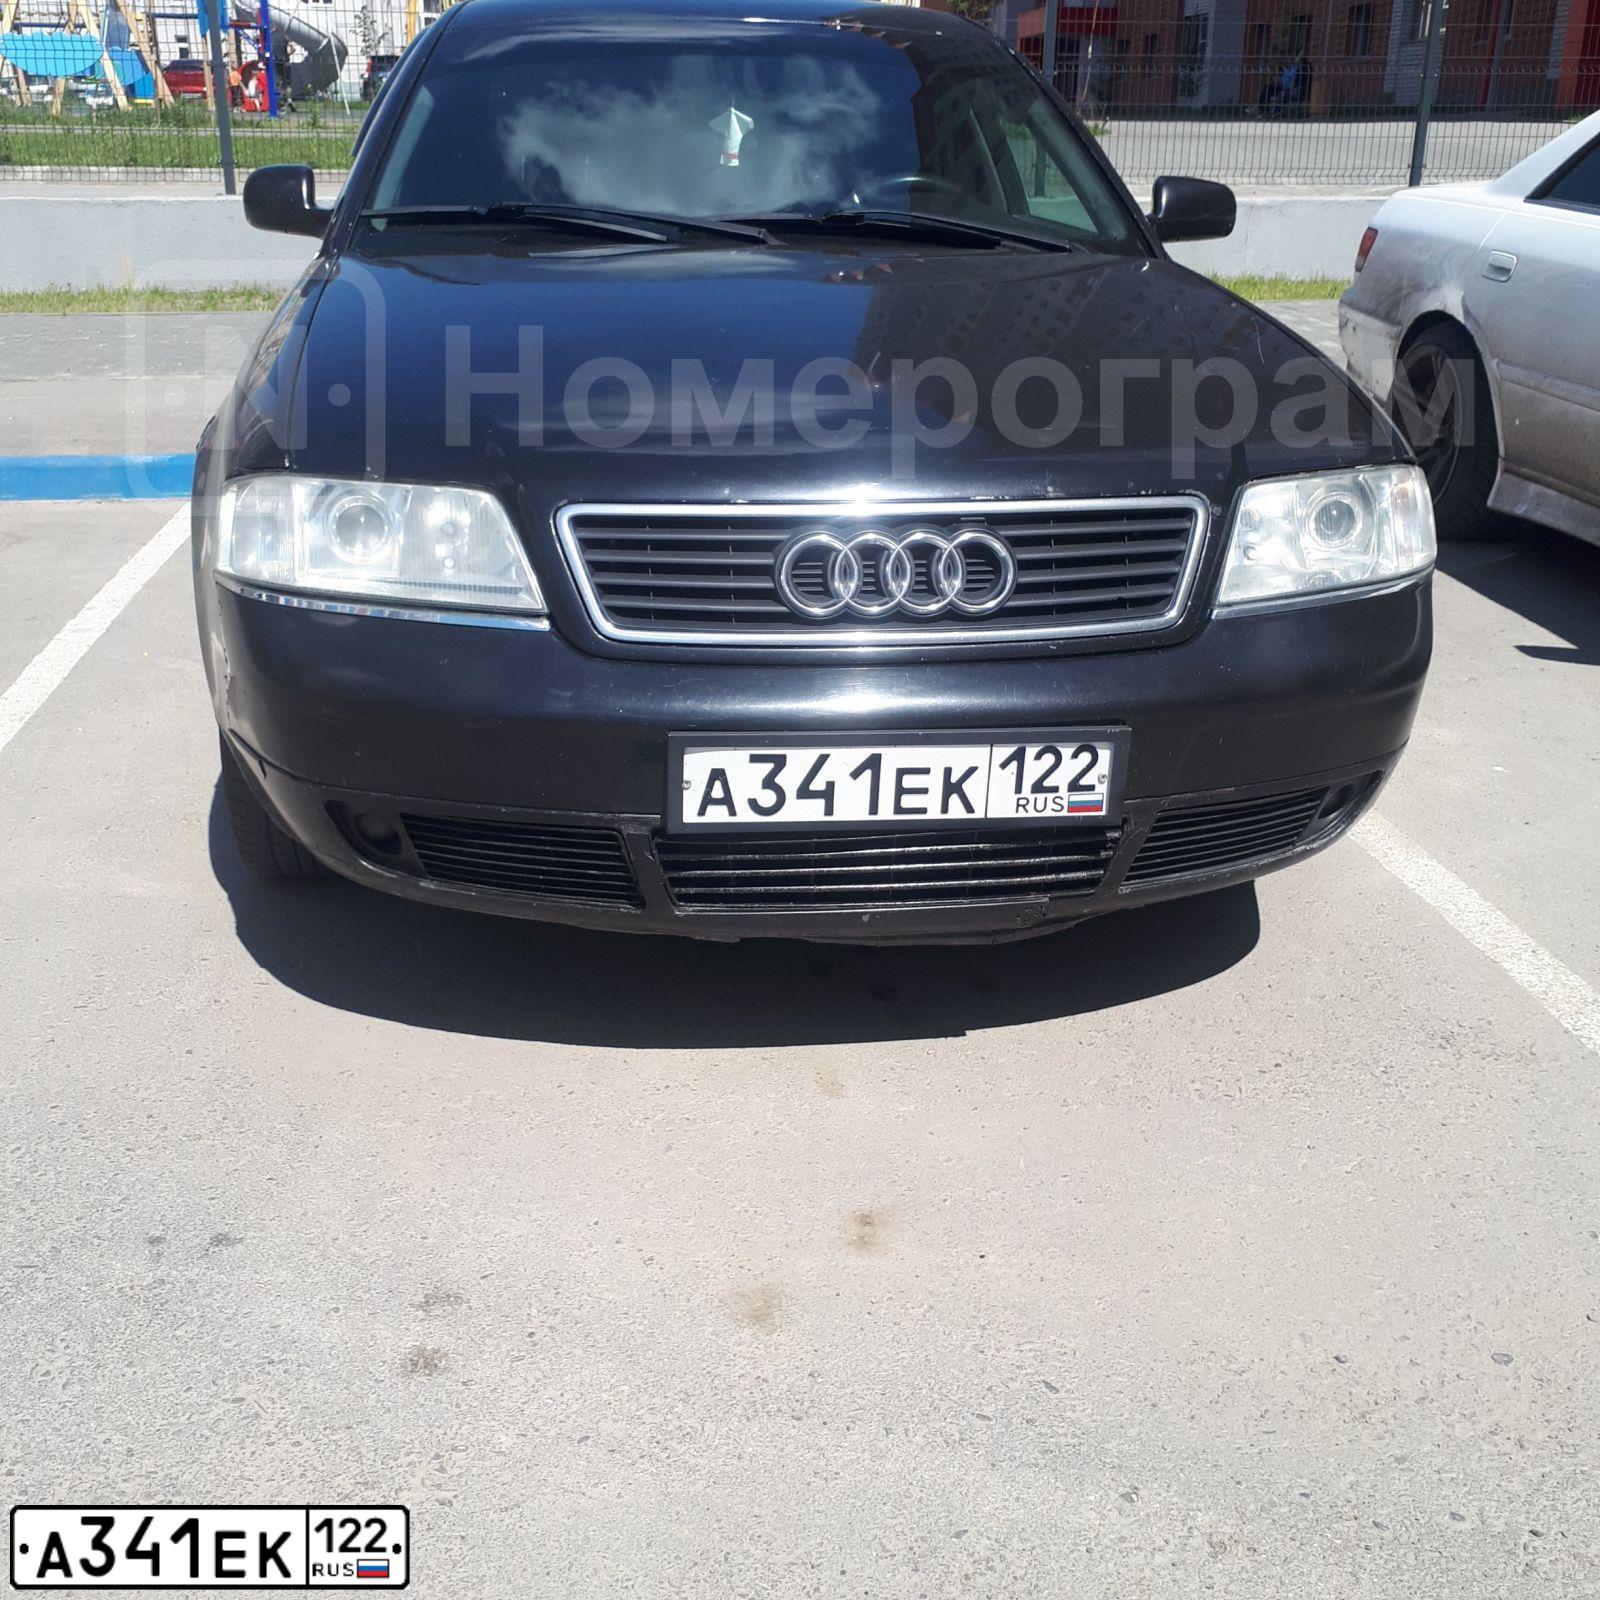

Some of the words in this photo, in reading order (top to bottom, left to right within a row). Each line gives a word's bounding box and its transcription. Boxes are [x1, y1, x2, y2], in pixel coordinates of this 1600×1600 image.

[697, 752, 980, 817] А341ЕК
[998, 744, 1100, 795] 122
[1014, 795, 1065, 814] RUS
